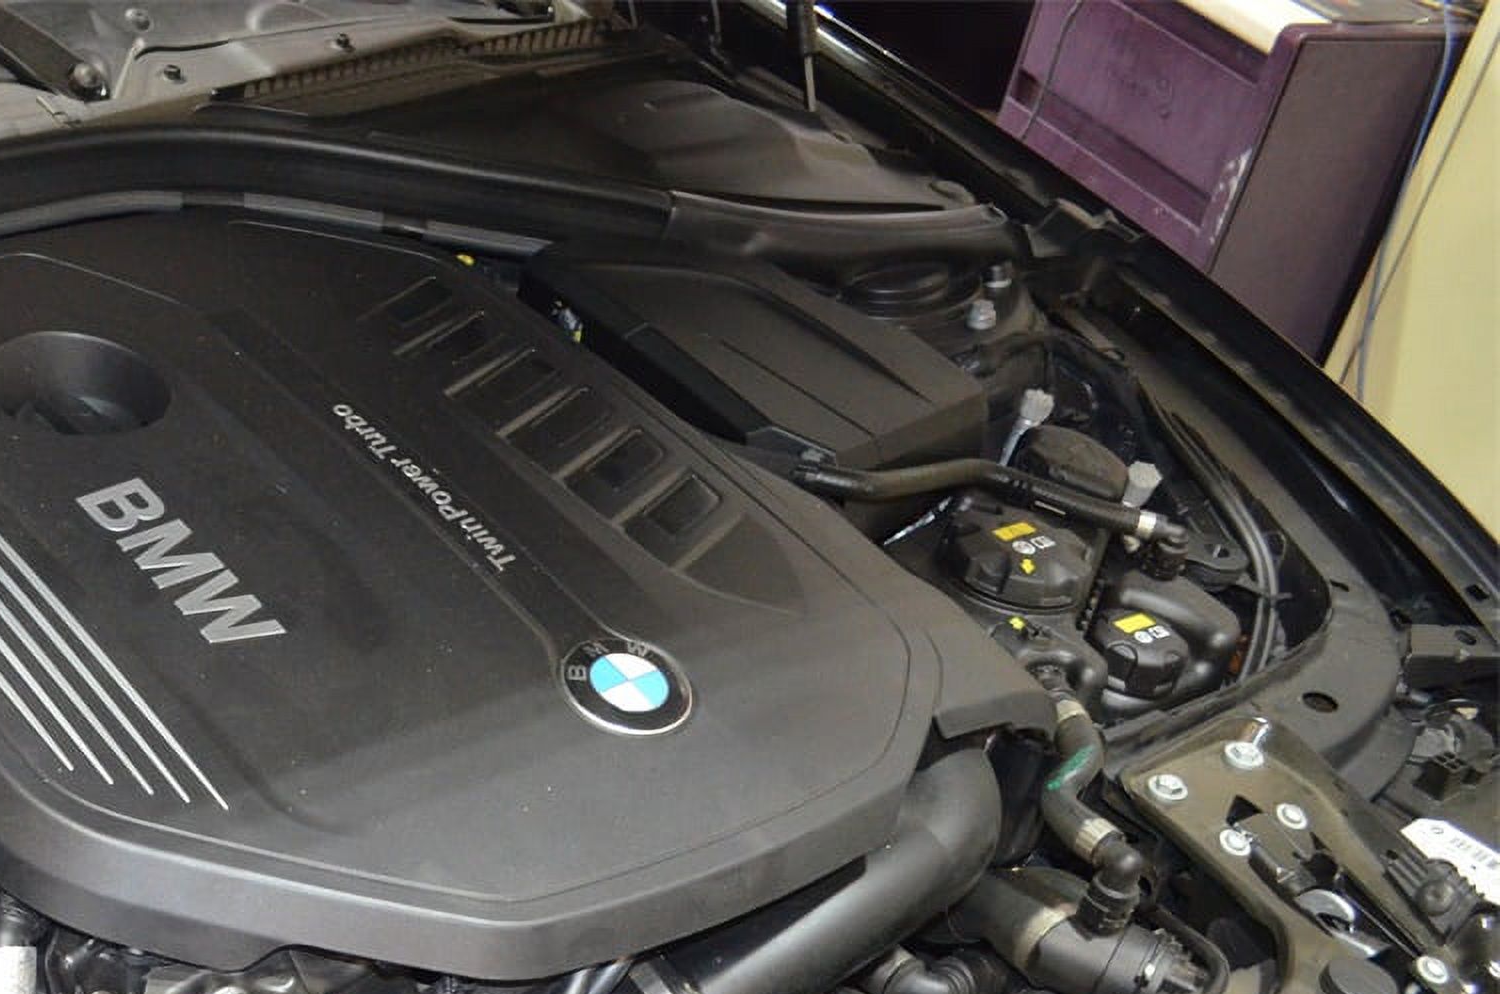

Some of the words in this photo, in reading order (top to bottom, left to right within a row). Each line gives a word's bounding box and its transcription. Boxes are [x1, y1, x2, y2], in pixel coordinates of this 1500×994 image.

[333, 404, 398, 460] Turbo
[75, 477, 287, 644] BMW
[567, 640, 649, 682] BMW
